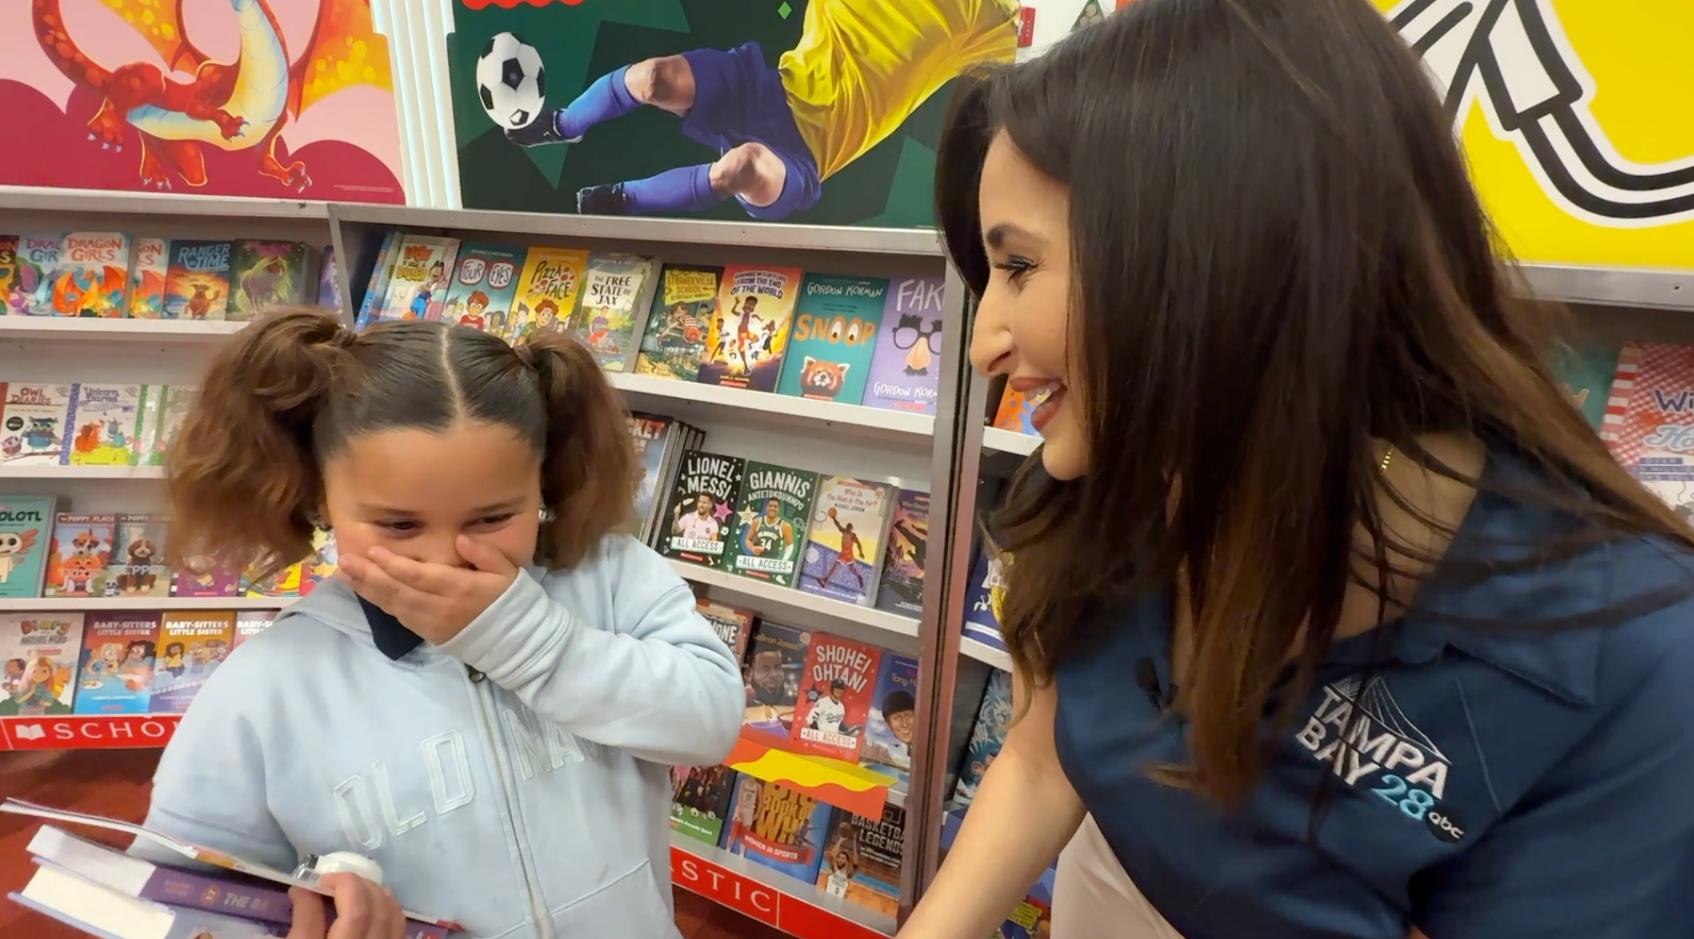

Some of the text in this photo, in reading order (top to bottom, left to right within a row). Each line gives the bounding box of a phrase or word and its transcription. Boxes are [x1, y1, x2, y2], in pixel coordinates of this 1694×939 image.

[67, 238, 122, 250] DRAGON
[71, 248, 116, 262] GIRLS
[178, 243, 231, 262] RANGER
[197, 254, 230, 268] TIME
[490, 264, 512, 284] EYES
[531, 261, 562, 284] PIZZA
[605, 276, 632, 286] FREE
[545, 279, 571, 300] FACE
[590, 283, 623, 296] STATE
[676, 285, 702, 295] SCHOOL
[731, 284, 784, 300] OF THE WORLD
[807, 281, 883, 298] GORDON KORMAN
[595, 295, 618, 306] JAX
[794, 313, 876, 347] SNOOP
[20, 387, 44, 397] OWL
[84, 386, 120, 399] Unicorn
[873, 381, 911, 396] GORDON
[11, 394, 52, 405] DIARIES
[688, 457, 735, 483] LIONEL
[687, 475, 732, 500] MESSI
[750, 470, 811, 499] GIANNIS
[677, 539, 719, 552] ALL ACCESS
[760, 538, 772, 551] 34
[742, 556, 788, 571] ALL ACCESS
[21, 620, 71, 635] Diary
[94, 621, 157, 629] BABY-SITTERS
[165, 621, 229, 629] BABY-SITTERS
[752, 633, 777, 644] LeBron
[816, 645, 872, 674] SHOHEI
[813, 664, 868, 693] OHTANI
[892, 672, 908, 687] Tony
[806, 730, 852, 747] ALL ACCESS
[1314, 685, 1449, 800] TAMPA
[1295, 715, 1381, 786] BAY
[333, 729, 477, 850] OLD
[764, 796, 799, 819] BOOK
[1371, 774, 1465, 839] 28 abc
[744, 834, 767, 851] WOMEN
[774, 848, 798, 860] SPORTS
[223, 892, 251, 909] THE
